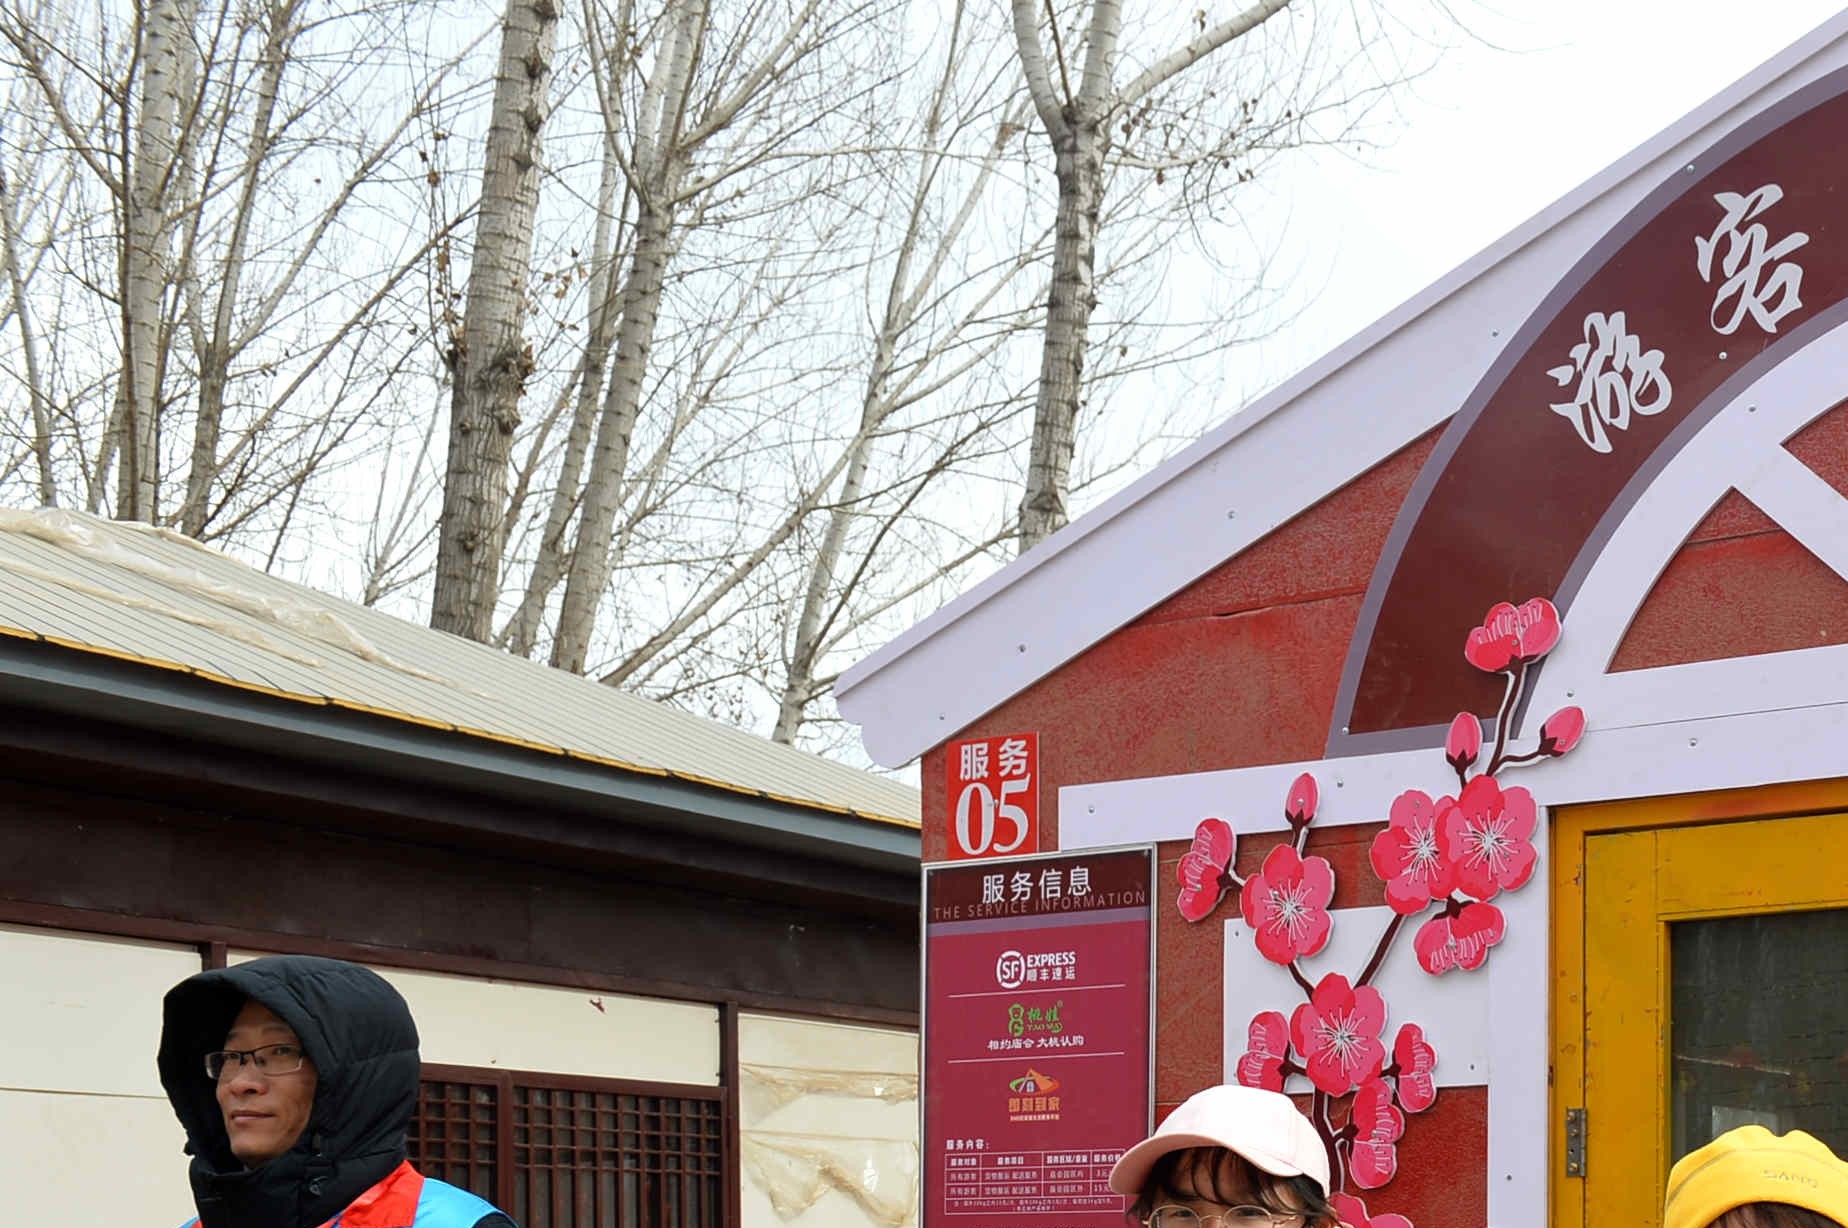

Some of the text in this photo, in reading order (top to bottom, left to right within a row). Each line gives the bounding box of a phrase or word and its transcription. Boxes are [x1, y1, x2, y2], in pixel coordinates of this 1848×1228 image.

[959, 738, 1028, 781] 服务
[955, 774, 1031, 855] 05
[982, 865, 1092, 904] 服务信息
[934, 890, 1146, 921] THE SERVICE INFORMATION
[1027, 951, 1077, 967] EXPRESS
